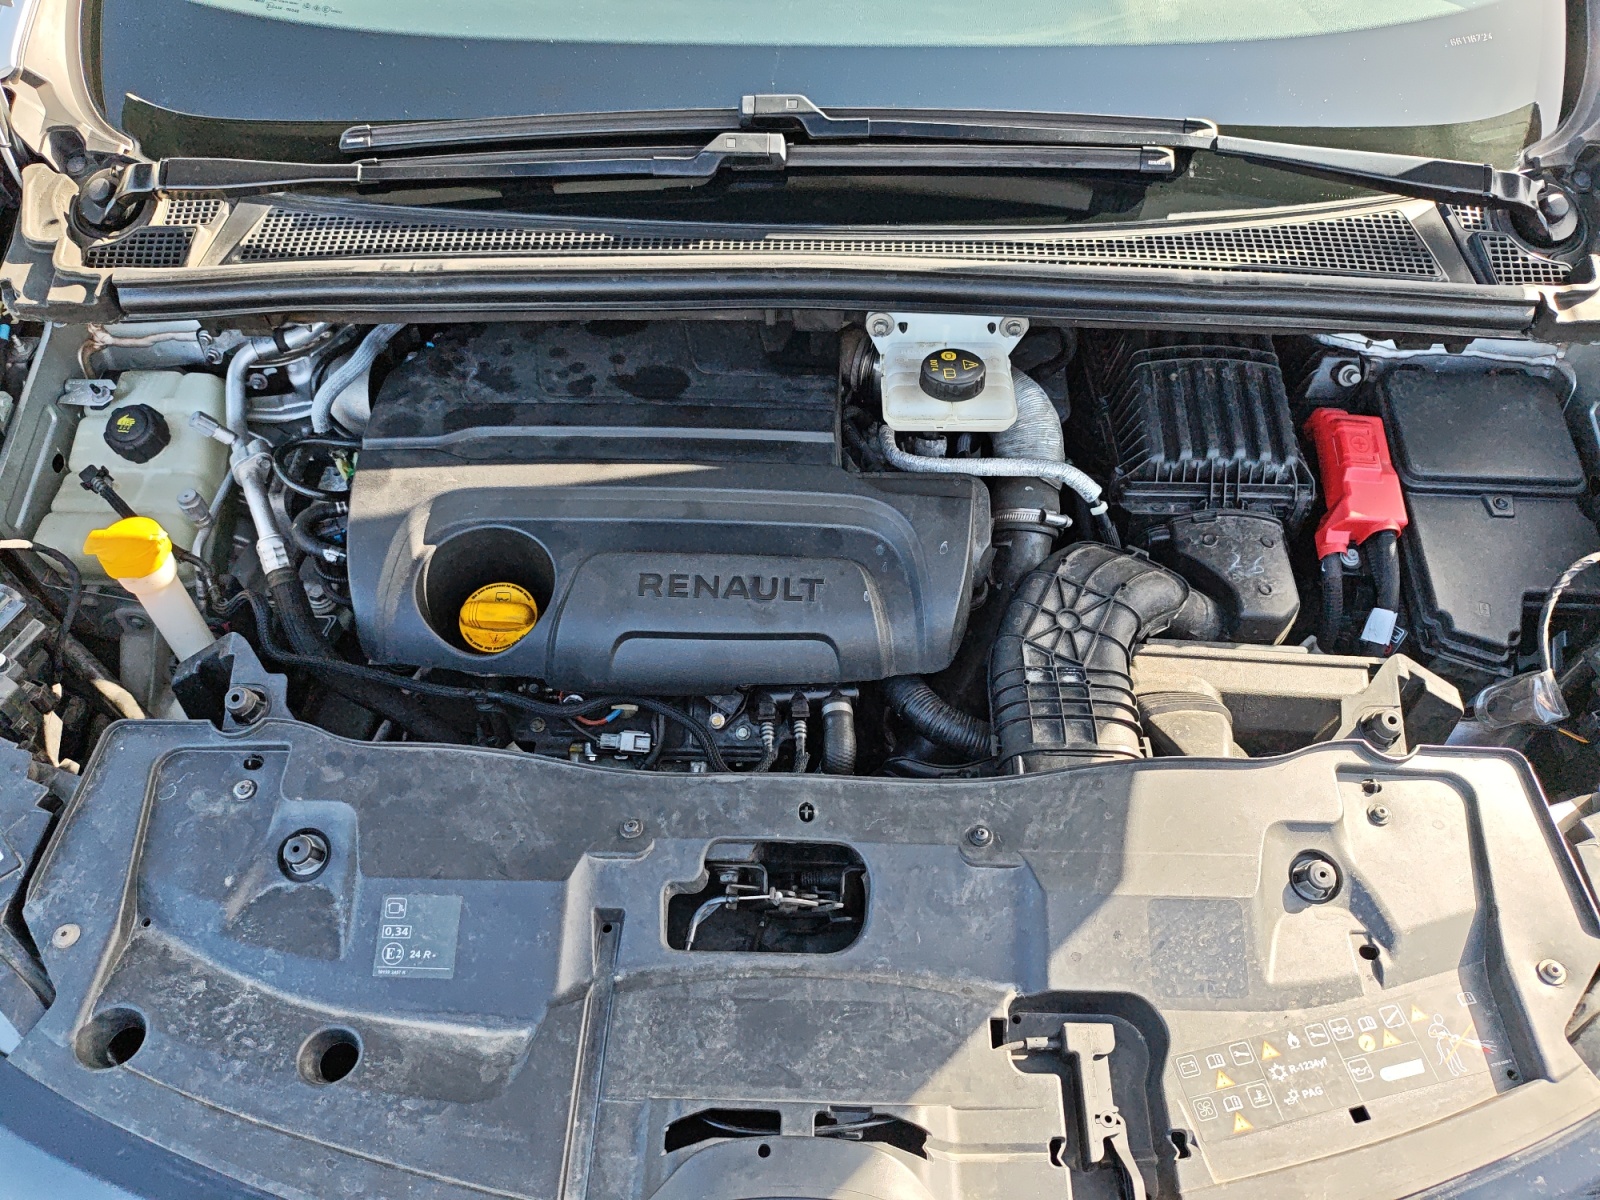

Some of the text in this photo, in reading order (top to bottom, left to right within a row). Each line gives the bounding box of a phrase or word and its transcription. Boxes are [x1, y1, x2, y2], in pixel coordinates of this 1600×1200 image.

[637, 572, 826, 602] RENAULT
[384, 926, 409, 937] 0,34
[409, 949, 421, 959] 24
[1287, 1056, 1328, 1075] R-1234yf
[1301, 1086, 1324, 1099] PAG
